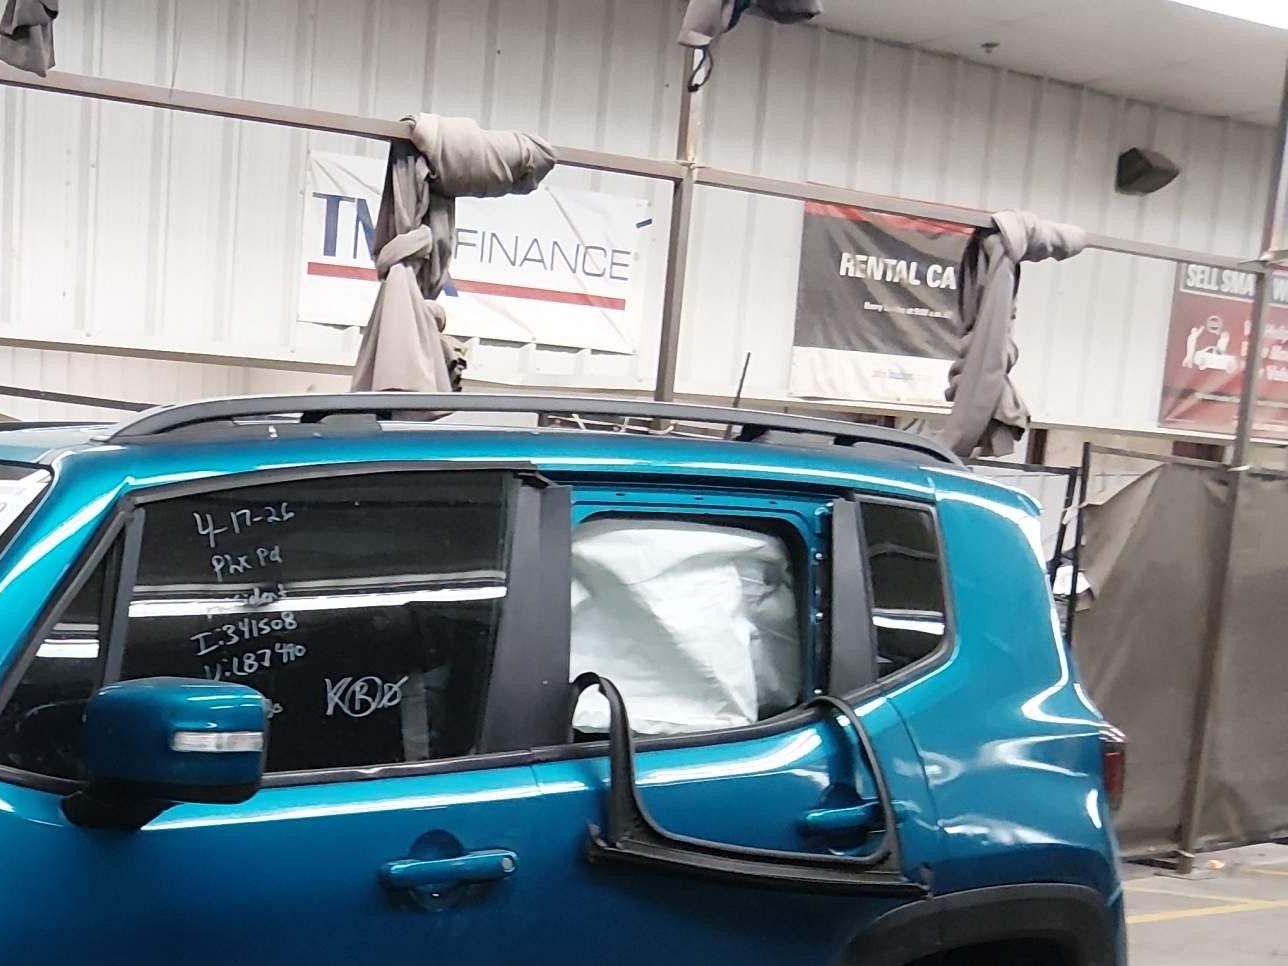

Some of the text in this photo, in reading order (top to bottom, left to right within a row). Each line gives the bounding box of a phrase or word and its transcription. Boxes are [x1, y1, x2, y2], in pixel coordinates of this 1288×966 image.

[453, 227, 631, 281] FINANCE
[839, 251, 921, 286] RENTAL
[1186, 264, 1220, 291] SELL
